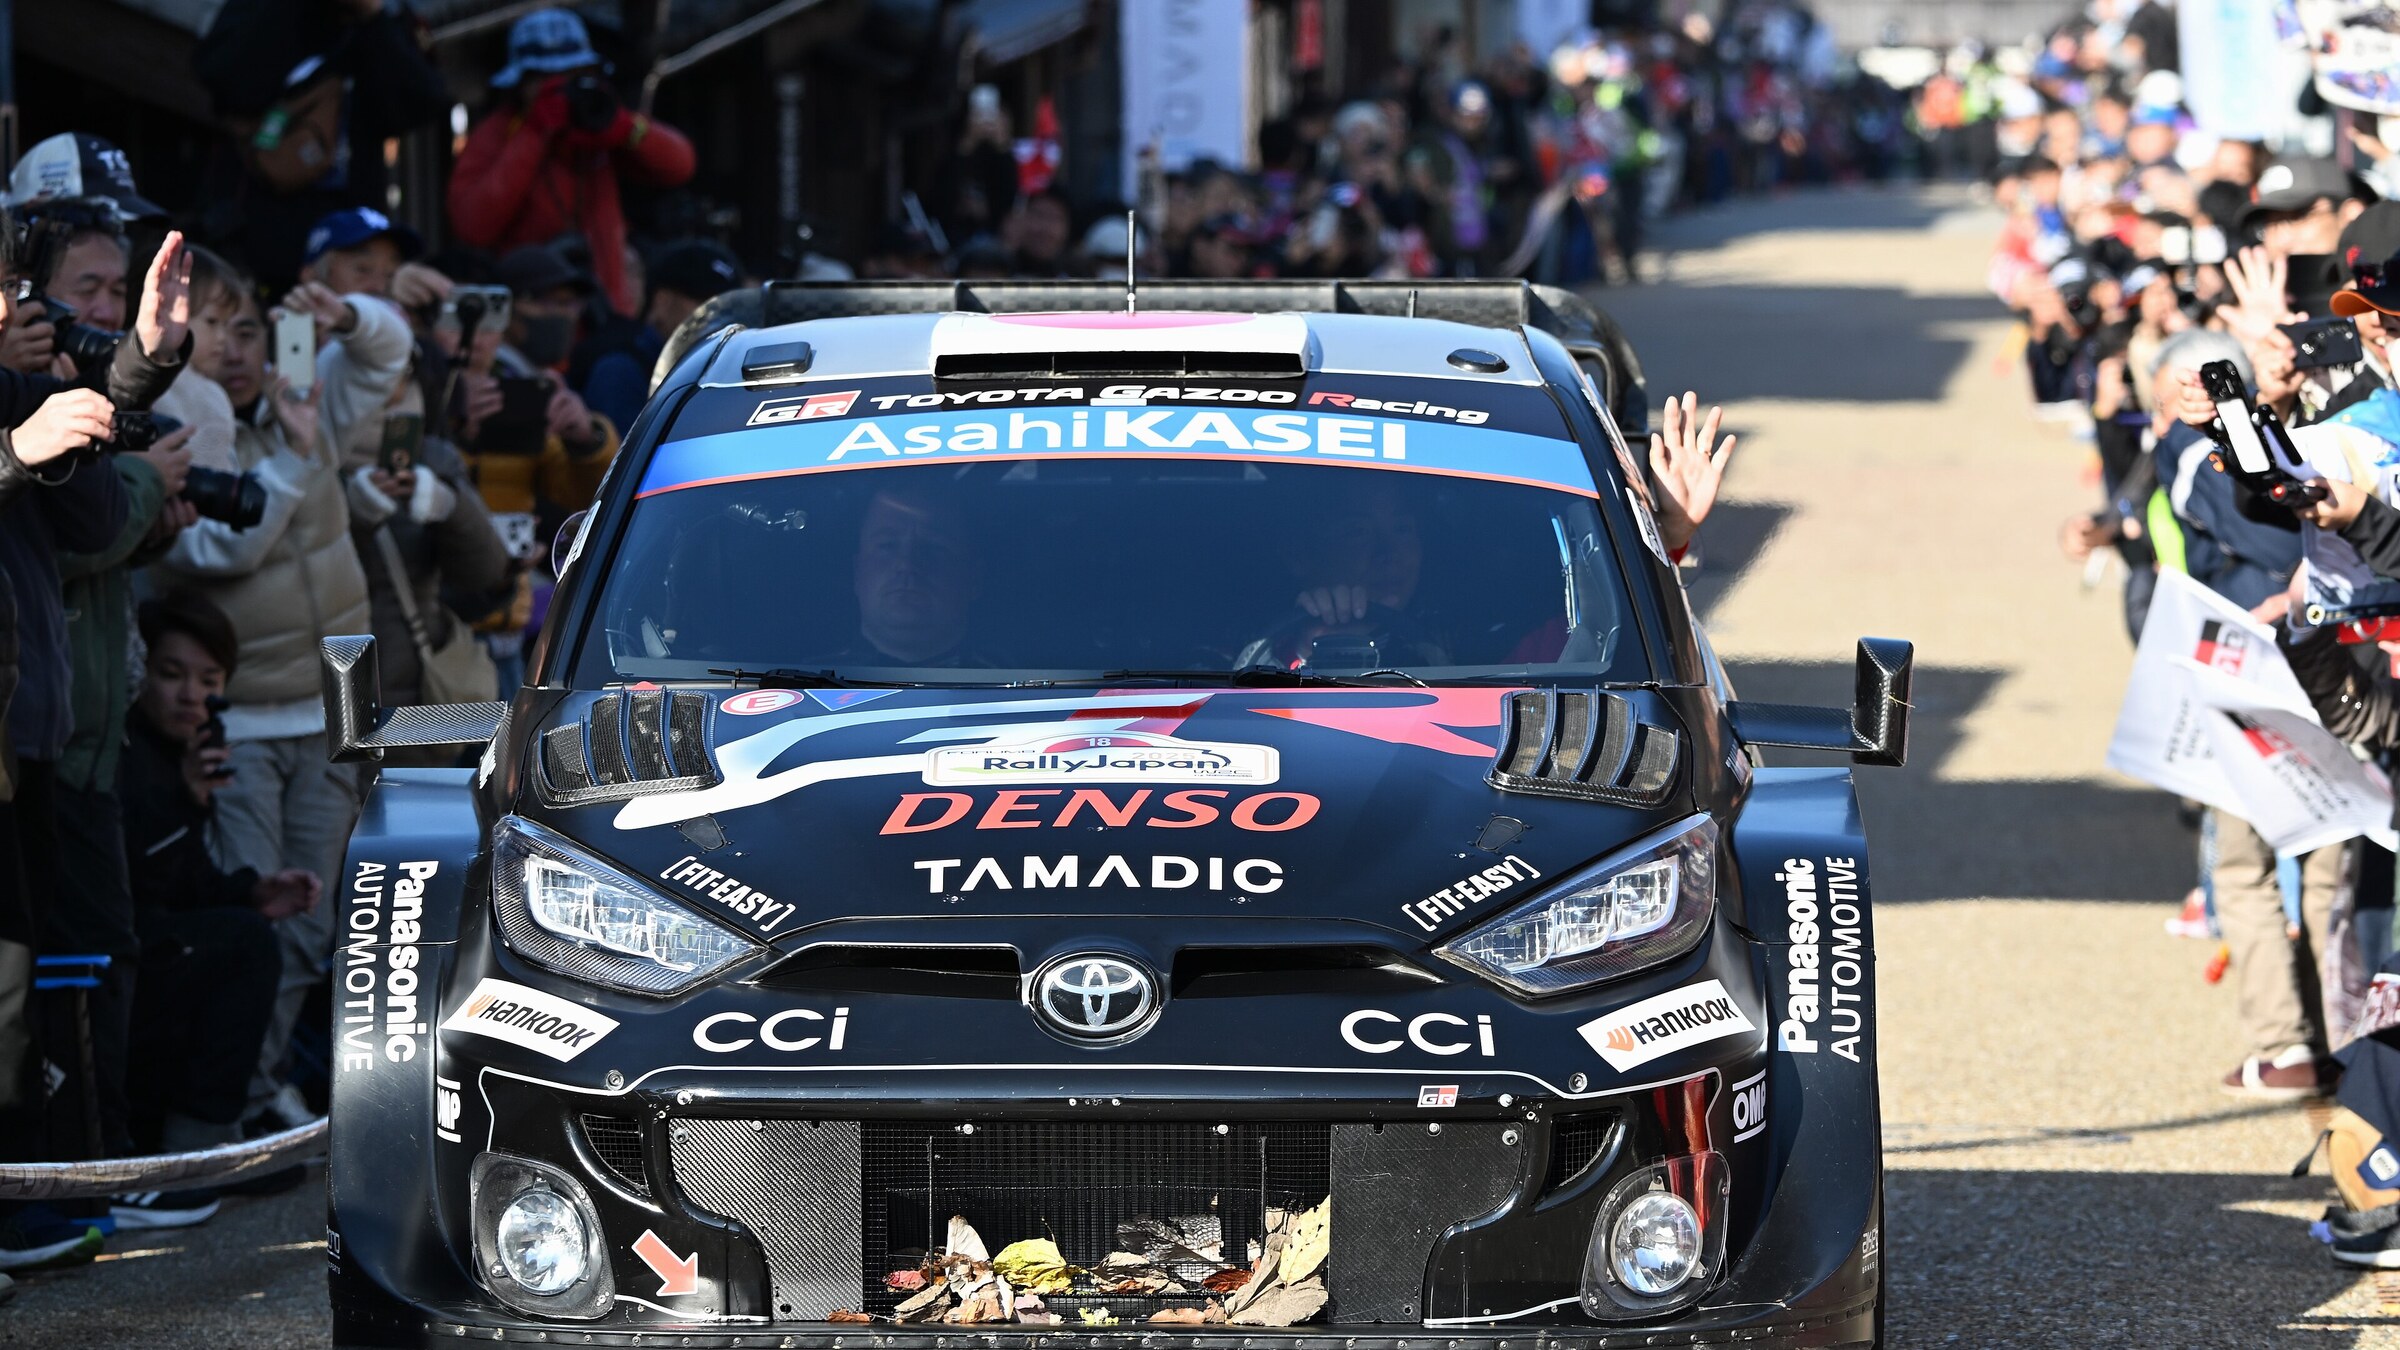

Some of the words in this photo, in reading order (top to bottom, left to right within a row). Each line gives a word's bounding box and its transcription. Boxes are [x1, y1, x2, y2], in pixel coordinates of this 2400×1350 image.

[750, 394, 856, 424] GR
[870, 387, 1083, 409] TOYOTA
[1099, 385, 1296, 404] GAZOO
[1308, 392, 1490, 424] Racing
[1085, 737, 1111, 747] 18
[879, 789, 1321, 835] DENSO
[913, 855, 1284, 893] TAMADIC
[343, 861, 387, 1073] AUTOMOTIVE
[385, 861, 440, 1063] Panasonic
[1774, 858, 1820, 1053] Panasonic
[1825, 856, 1862, 1063] AUTOMOTIVE
[1419, 1090, 1457, 1106] GR
